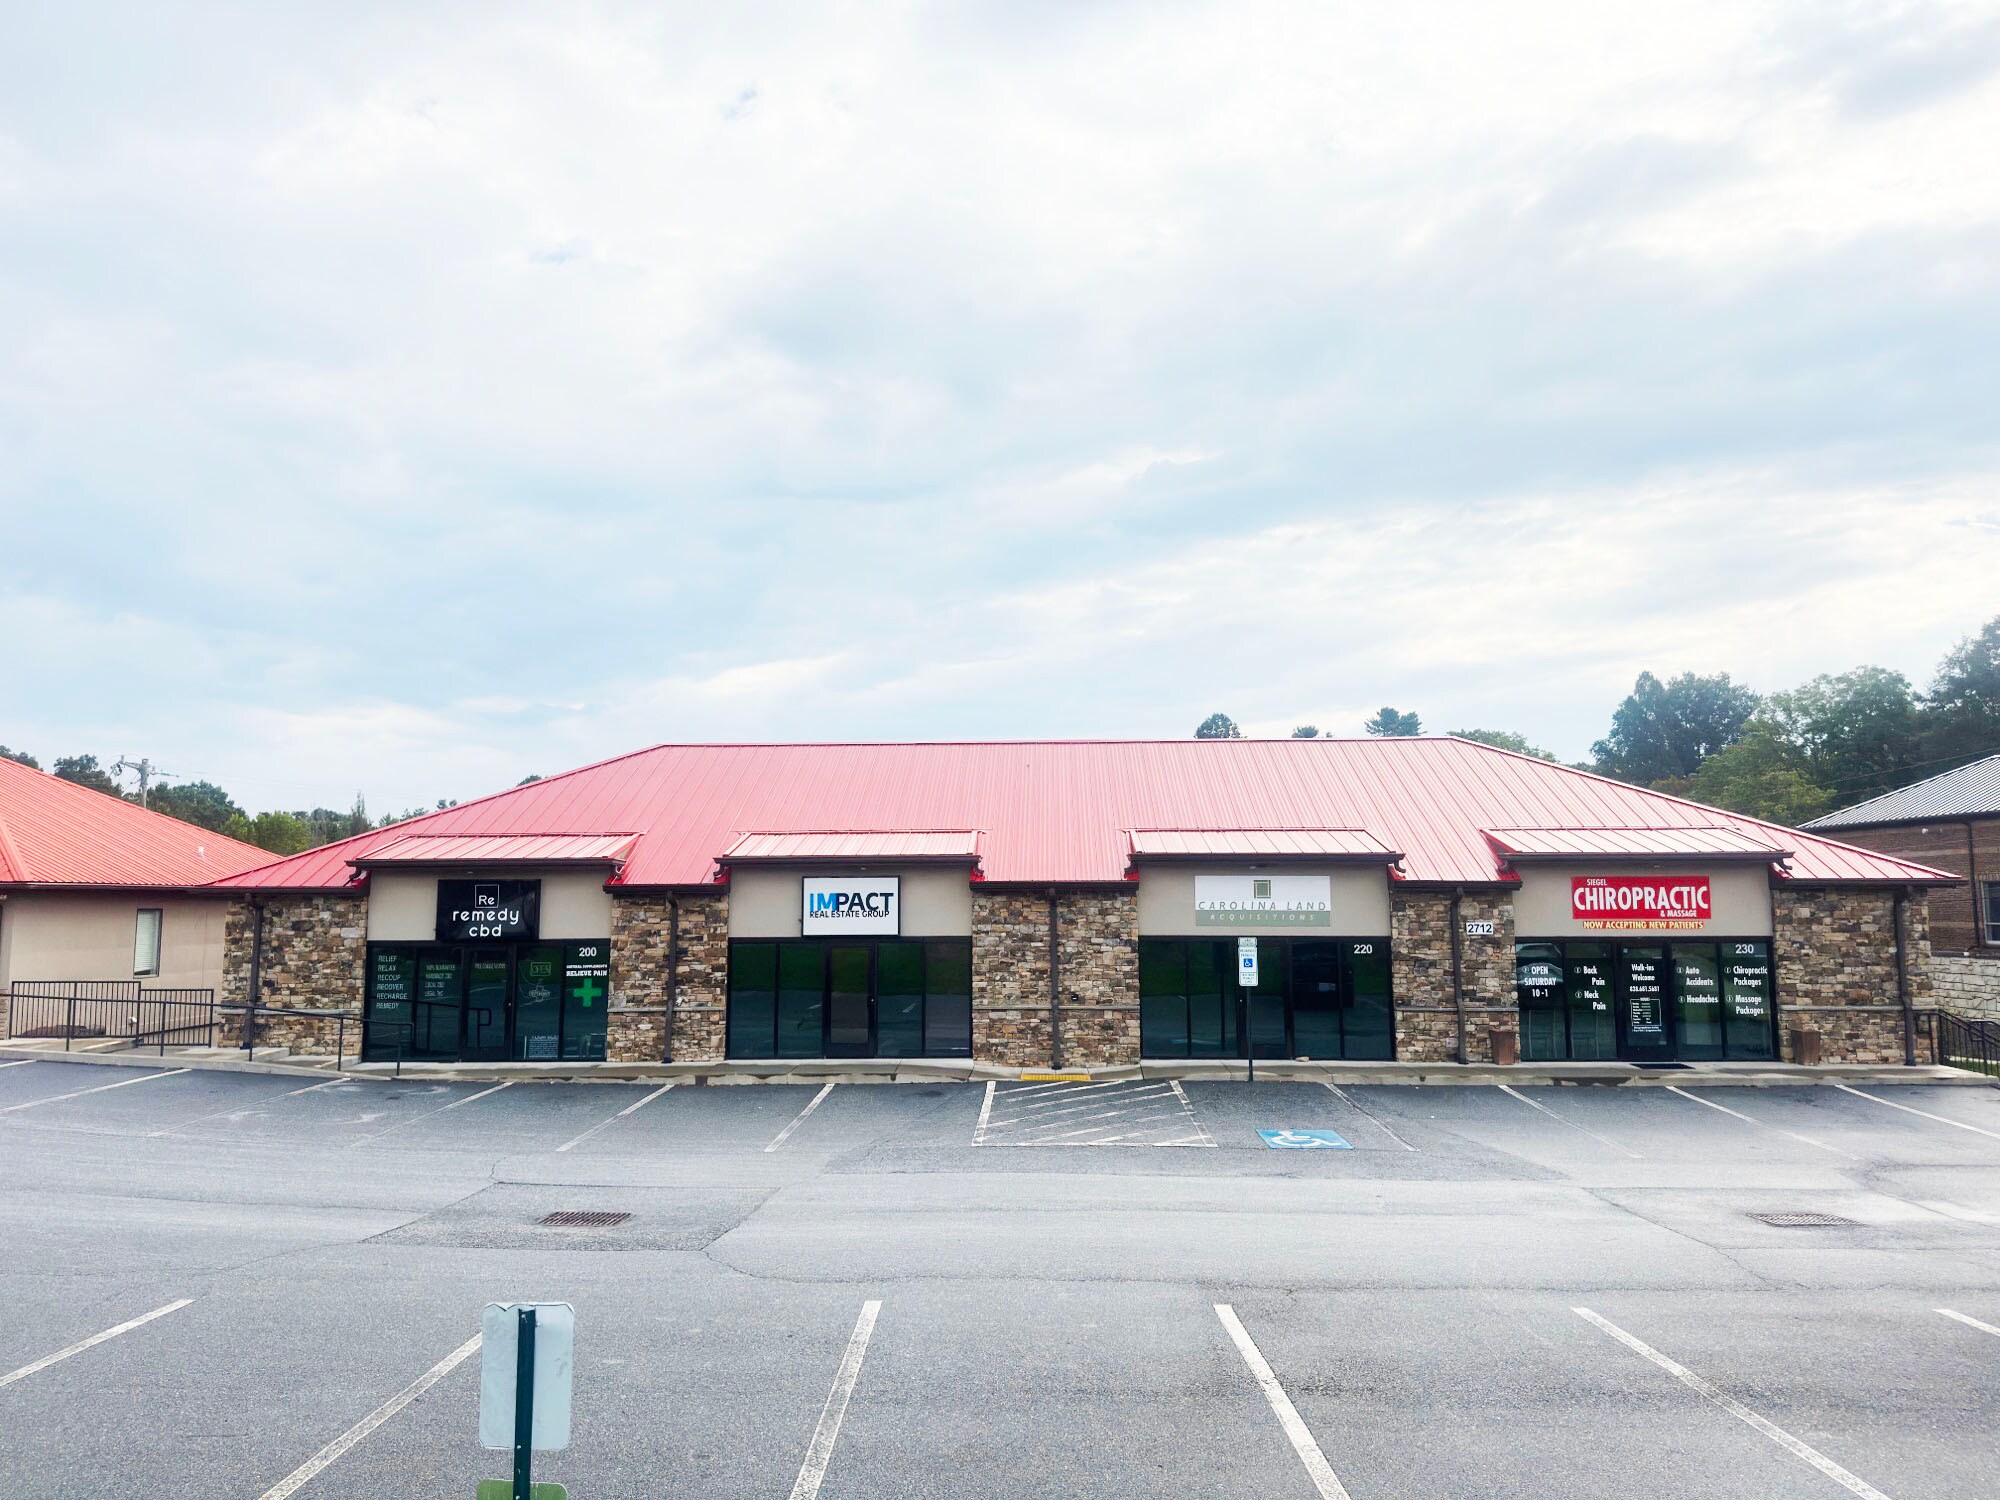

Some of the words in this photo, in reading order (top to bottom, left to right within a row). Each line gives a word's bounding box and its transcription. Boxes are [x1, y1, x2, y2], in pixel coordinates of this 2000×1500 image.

[478, 895, 495, 905] Re
[810, 892, 894, 912] IMPACT
[1574, 886, 1709, 910] CHIROPRACTIC
[1198, 901, 1276, 911] CAROLINA
[1286, 902, 1326, 911] LAND
[452, 908, 519, 925] remedy
[1210, 913, 1314, 922] ACQUISITIONS
[469, 924, 502, 937] cbd
[1468, 924, 1492, 933] 2712
[579, 947, 596, 956] 200
[1354, 945, 1372, 954] 220
[1736, 944, 1754, 954] 230
[1531, 966, 1548, 974] OPEN
[1584, 966, 1597, 974] Back
[1685, 966, 1700, 974] Auto
[1733, 966, 1768, 976] Chiropractic
[1525, 977, 1556, 986] SATURDAY
[1592, 977, 1605, 986] Pain
[1686, 977, 1714, 986] Accidents
[1734, 977, 1761, 987] Packages
[1584, 990, 1599, 998] Neck
[1686, 994, 1718, 1003] Headaches
[1735, 995, 1762, 1005] Massage
[1593, 1002, 1606, 1010] Pain
[1736, 1006, 1764, 1016] Packages
